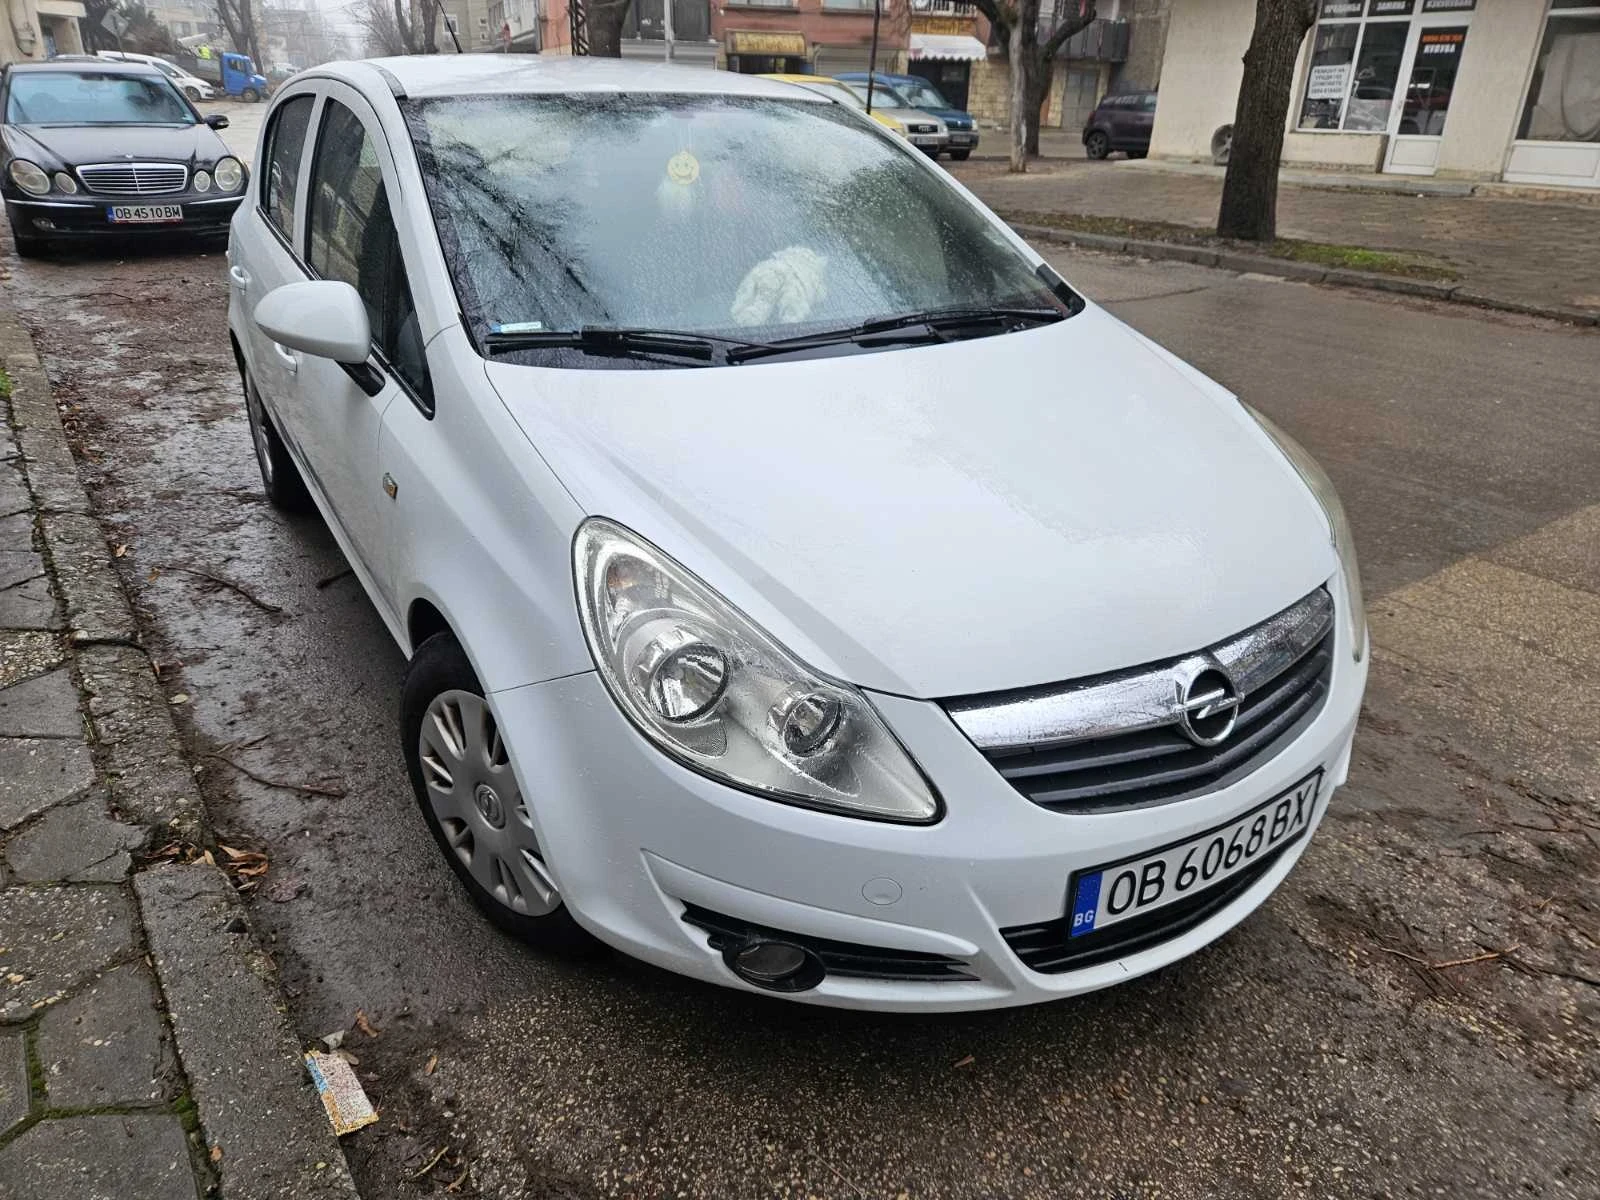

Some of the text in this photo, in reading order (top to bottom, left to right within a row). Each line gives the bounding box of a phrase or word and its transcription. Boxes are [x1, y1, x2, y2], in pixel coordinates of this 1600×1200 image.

[134, 207, 163, 219] 4510
[1106, 783, 1313, 916] OB 6068 BX
[1073, 909, 1095, 928] BG
